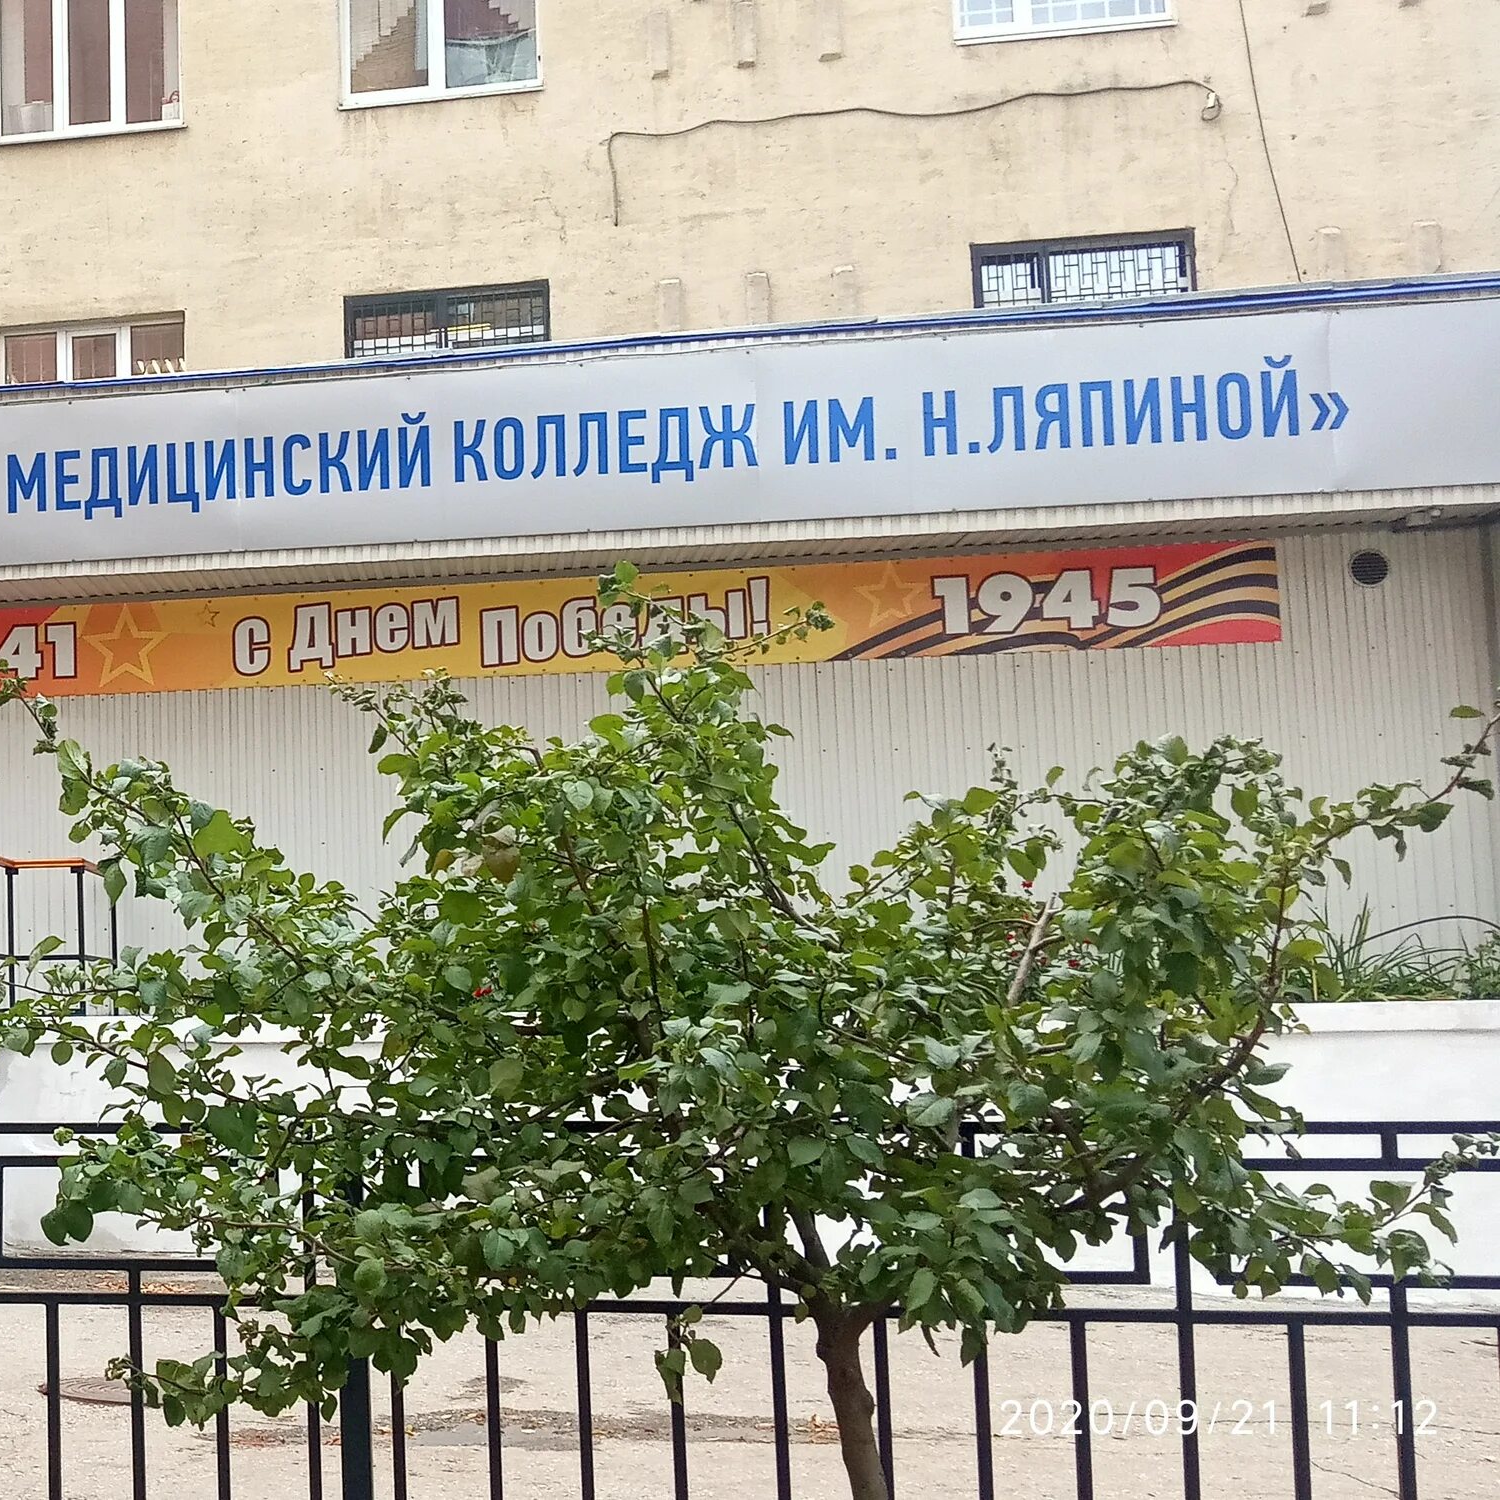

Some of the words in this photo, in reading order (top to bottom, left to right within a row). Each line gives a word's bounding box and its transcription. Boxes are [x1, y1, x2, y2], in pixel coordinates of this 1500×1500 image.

[7, 411, 433, 520] МЕДИЦИНСКИЙ
[453, 402, 758, 484] КОЛЛЕДЖ
[784, 396, 897, 465] ИМ.
[922, 355, 1350, 457] Н.ЛЯПИНОЙ»
[288, 596, 460, 672] Днем
[931, 565, 1163, 636] 1945
